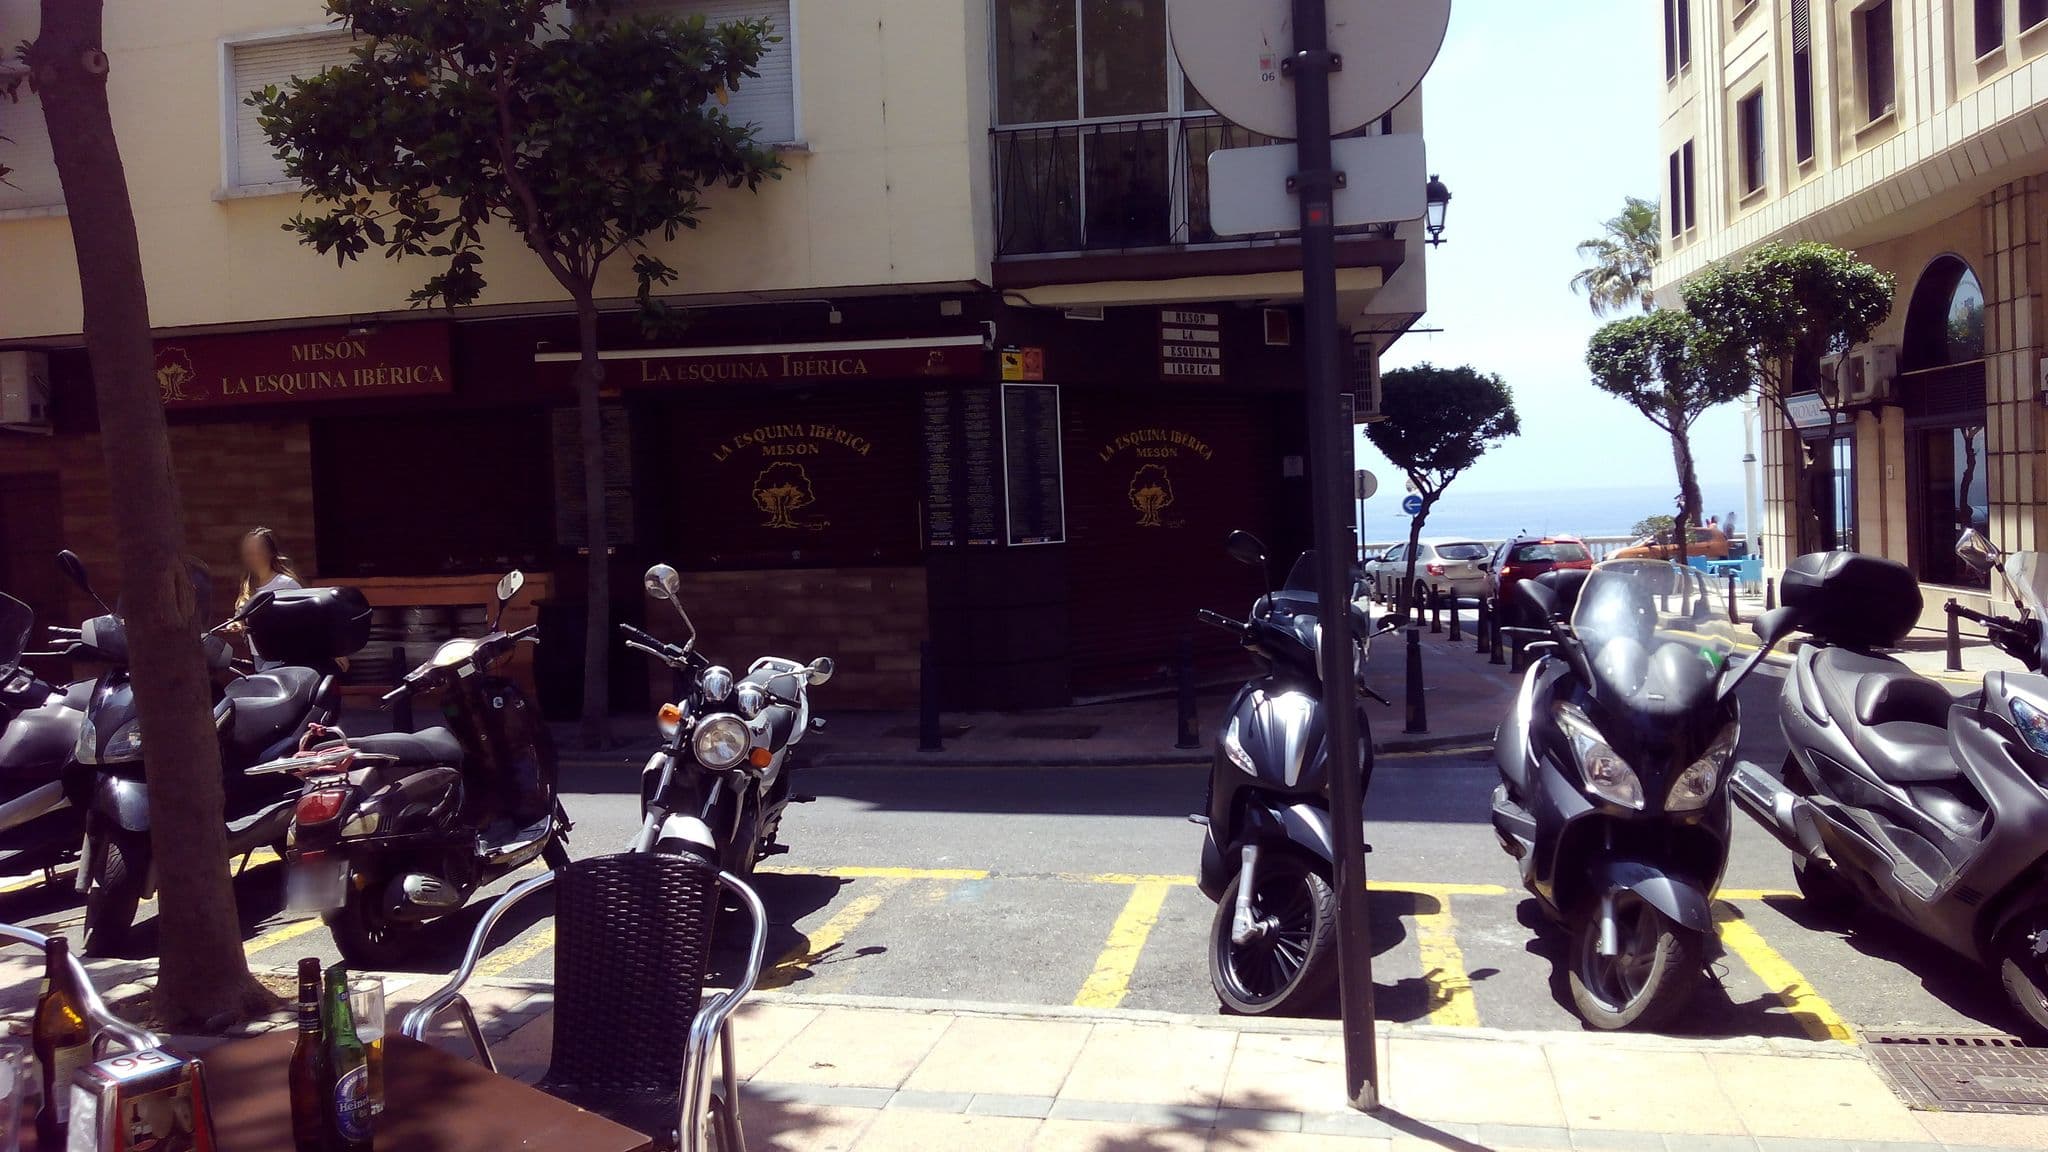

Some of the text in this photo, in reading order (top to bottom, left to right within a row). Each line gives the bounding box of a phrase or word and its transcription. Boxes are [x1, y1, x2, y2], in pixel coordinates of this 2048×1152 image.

[1261, 72, 1275, 82] 06
[1175, 313, 1206, 324] MESON
[1182, 330, 1194, 341] LA
[291, 337, 366, 362] MESÓN
[1170, 347, 1213, 358] ESQUINA
[1172, 364, 1213, 375] IBERICA
[222, 363, 444, 395] LA ESQUINA IBÉRICA
[711, 444, 733, 463] LA
[733, 424, 804, 448] ESQUINA
[1098, 445, 1115, 463] LA
[1115, 429, 1167, 450] ESQUINA
[111, 1051, 165, 1071] 56
